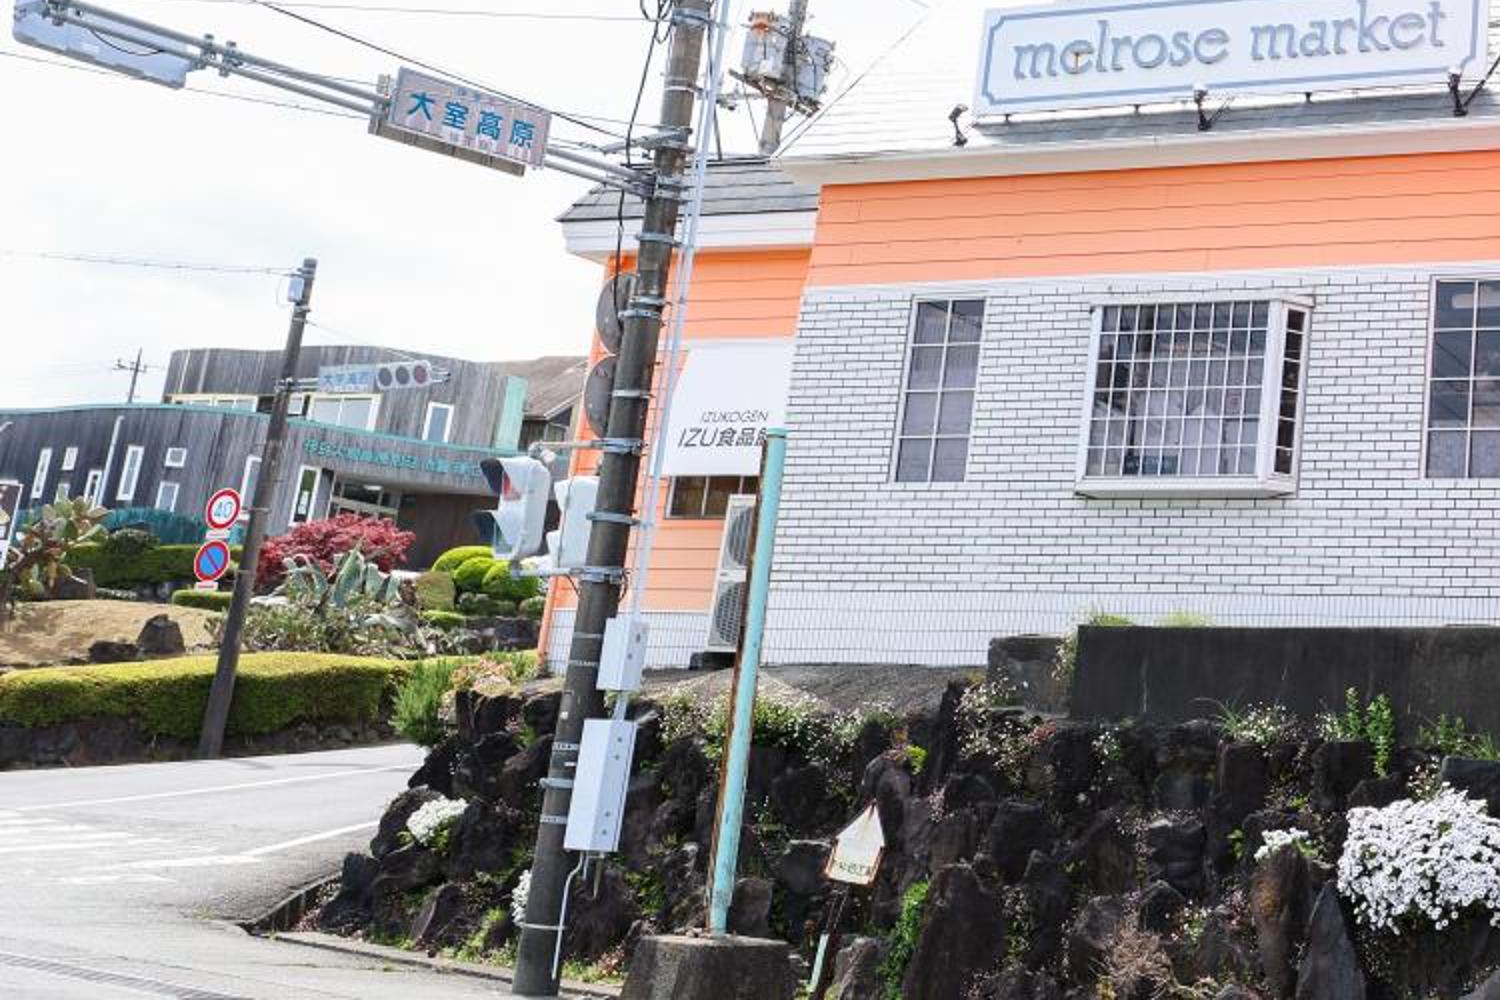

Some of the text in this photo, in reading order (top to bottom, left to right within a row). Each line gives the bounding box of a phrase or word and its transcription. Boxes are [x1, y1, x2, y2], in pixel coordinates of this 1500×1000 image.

[1013, 18, 1230, 81] melrose
[407, 91, 536, 149] 大室高原
[214, 500, 234, 519] 40
